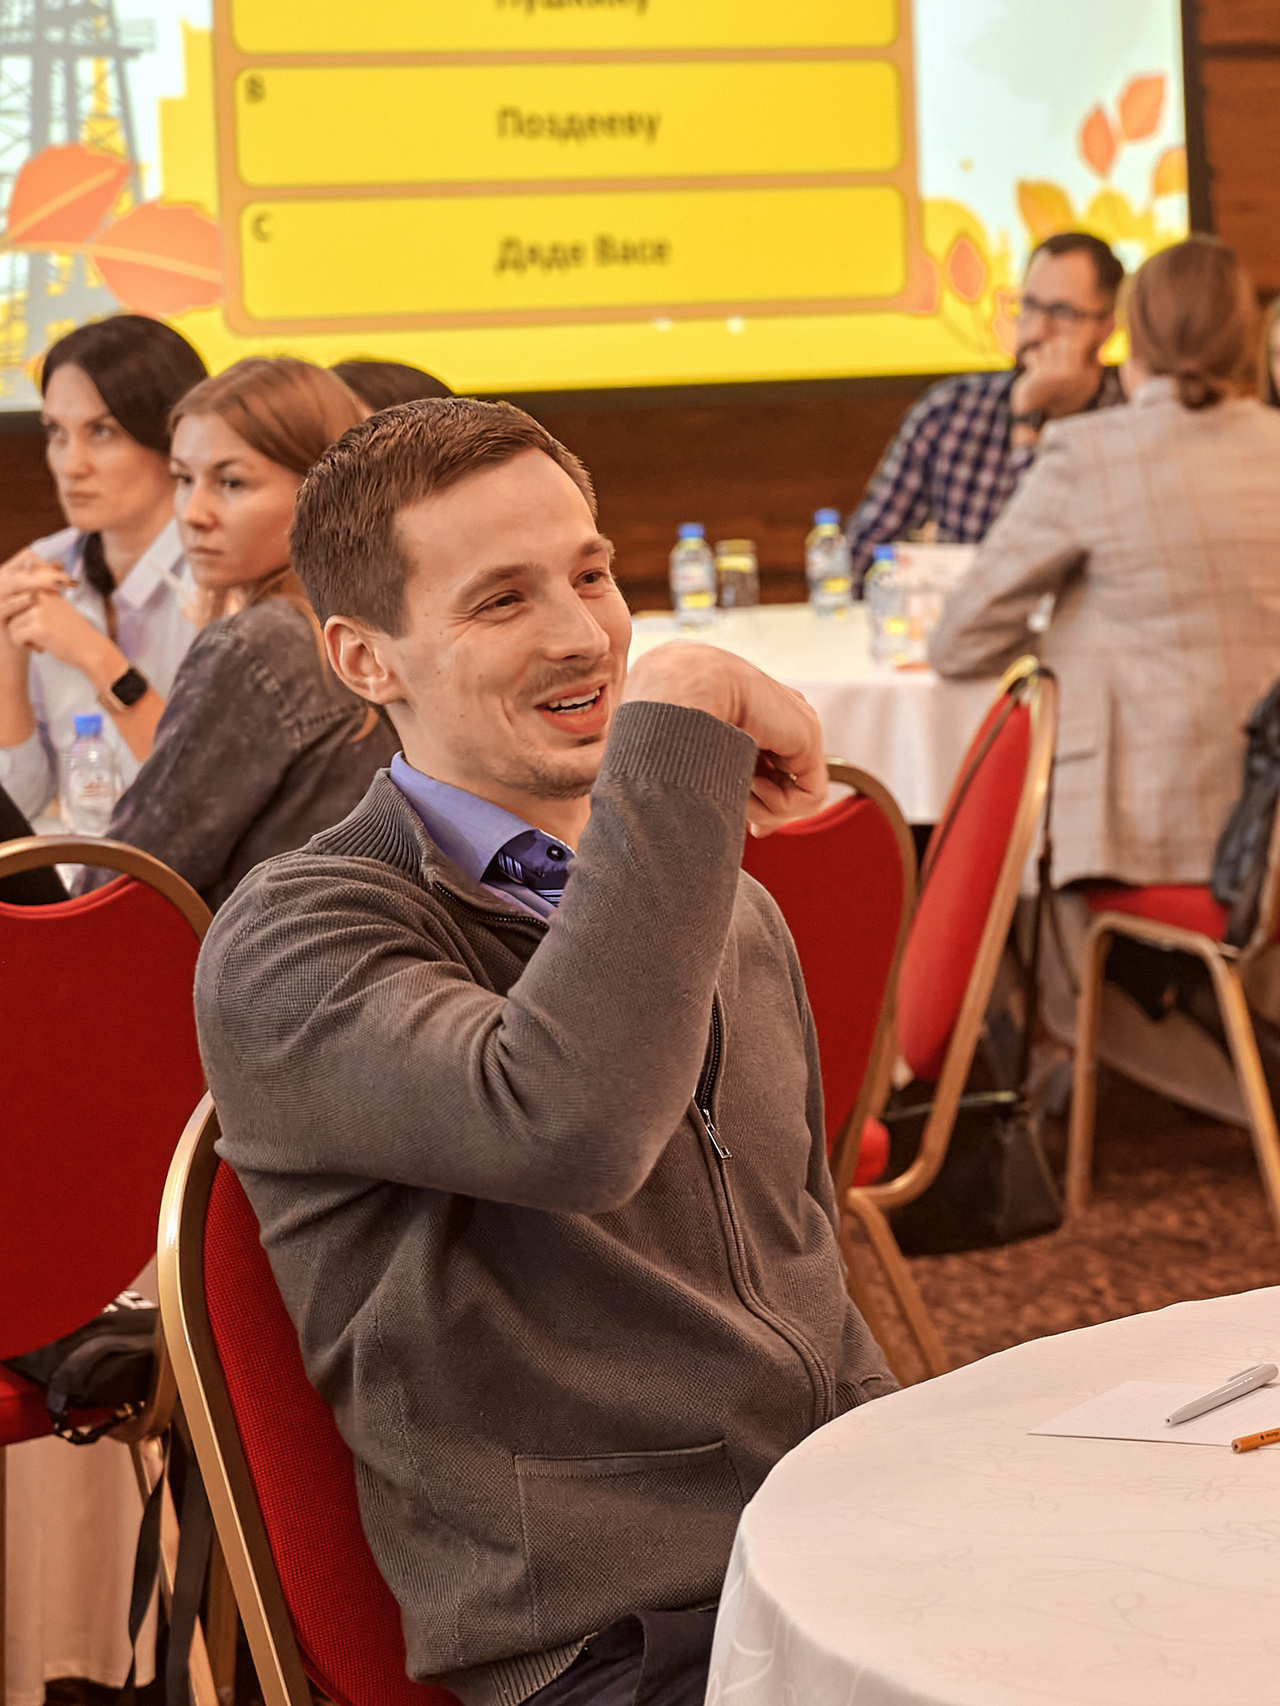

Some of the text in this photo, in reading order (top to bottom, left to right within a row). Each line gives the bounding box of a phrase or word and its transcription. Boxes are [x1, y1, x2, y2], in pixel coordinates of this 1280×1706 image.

[498, 105, 660, 143] Поздееву
[494, 233, 671, 275] Дяде Васе
